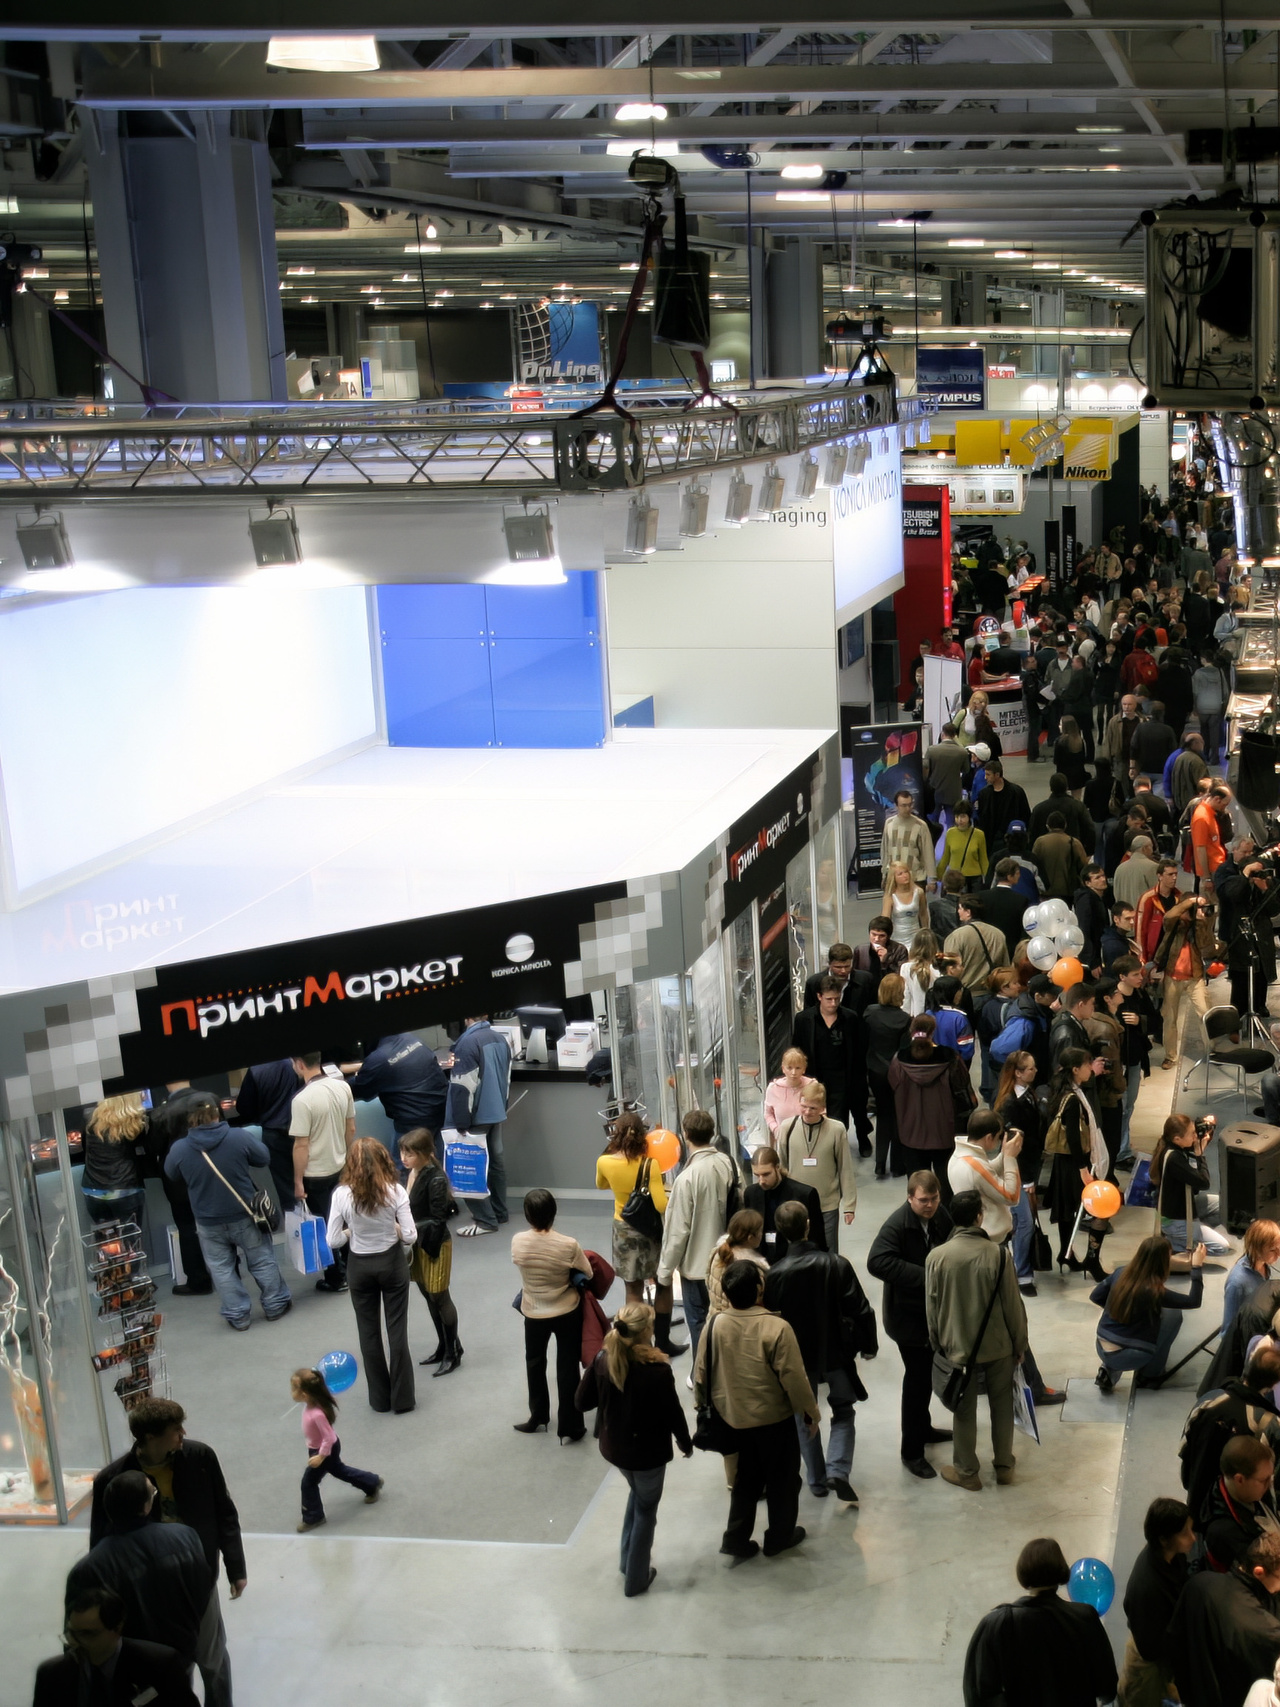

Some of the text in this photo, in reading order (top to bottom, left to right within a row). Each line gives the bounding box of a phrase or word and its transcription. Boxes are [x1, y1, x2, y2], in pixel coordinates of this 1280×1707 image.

[1065, 466, 1108, 479] Nikon
[833, 470, 899, 521] KONICA MINOLTA
[902, 510, 939, 519] TSUBISHI
[903, 518, 933, 527] ECTRIC
[730, 811, 791, 882] ПринтМаркет
[491, 959, 552, 978] KONICA MINOLTA
[160, 955, 464, 1038] ПринтМаркет
